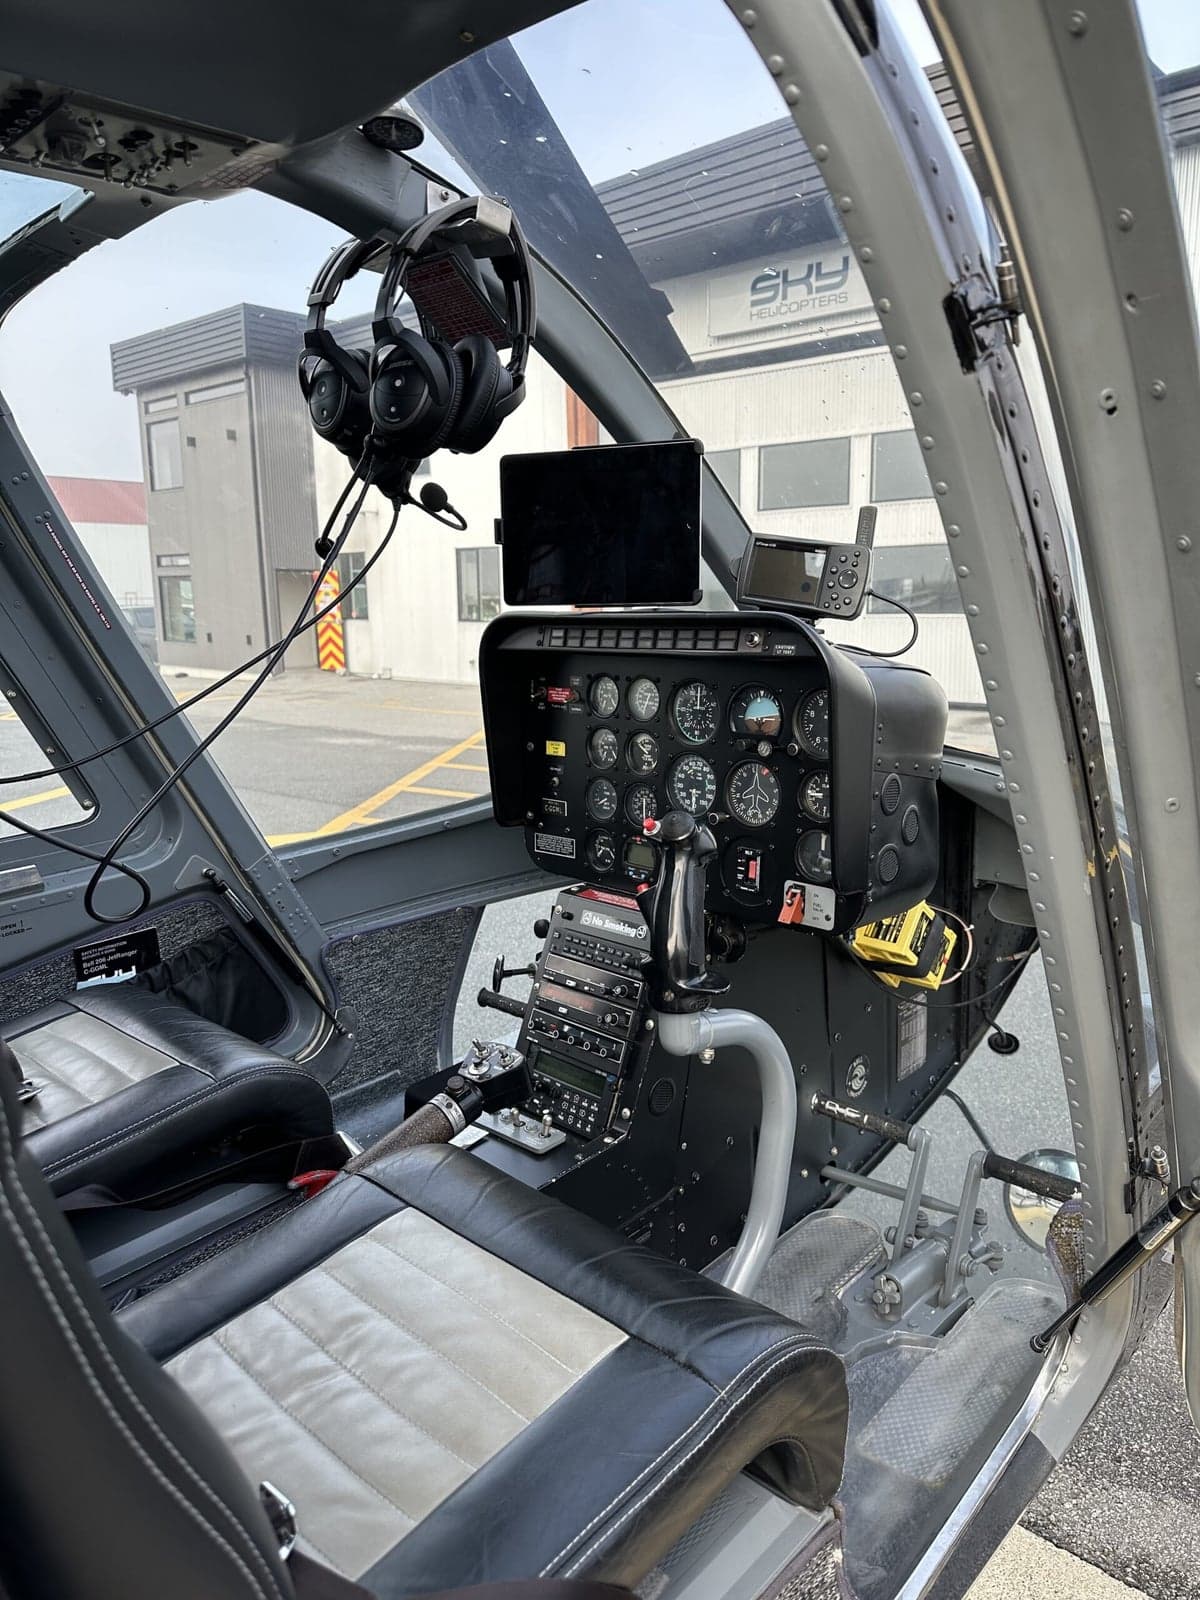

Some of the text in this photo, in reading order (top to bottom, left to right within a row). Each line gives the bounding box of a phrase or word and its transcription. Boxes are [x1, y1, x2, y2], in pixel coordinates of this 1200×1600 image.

[750, 256, 849, 307] SKY
[750, 292, 848, 320] HELICOPTERS
[810, 710, 815, 718] 8
[591, 916, 637, 938] No Smoking
[82, 959, 95, 969] Bell
[107, 949, 138, 962] JetRanger
[83, 963, 109, 975] C-GGML
